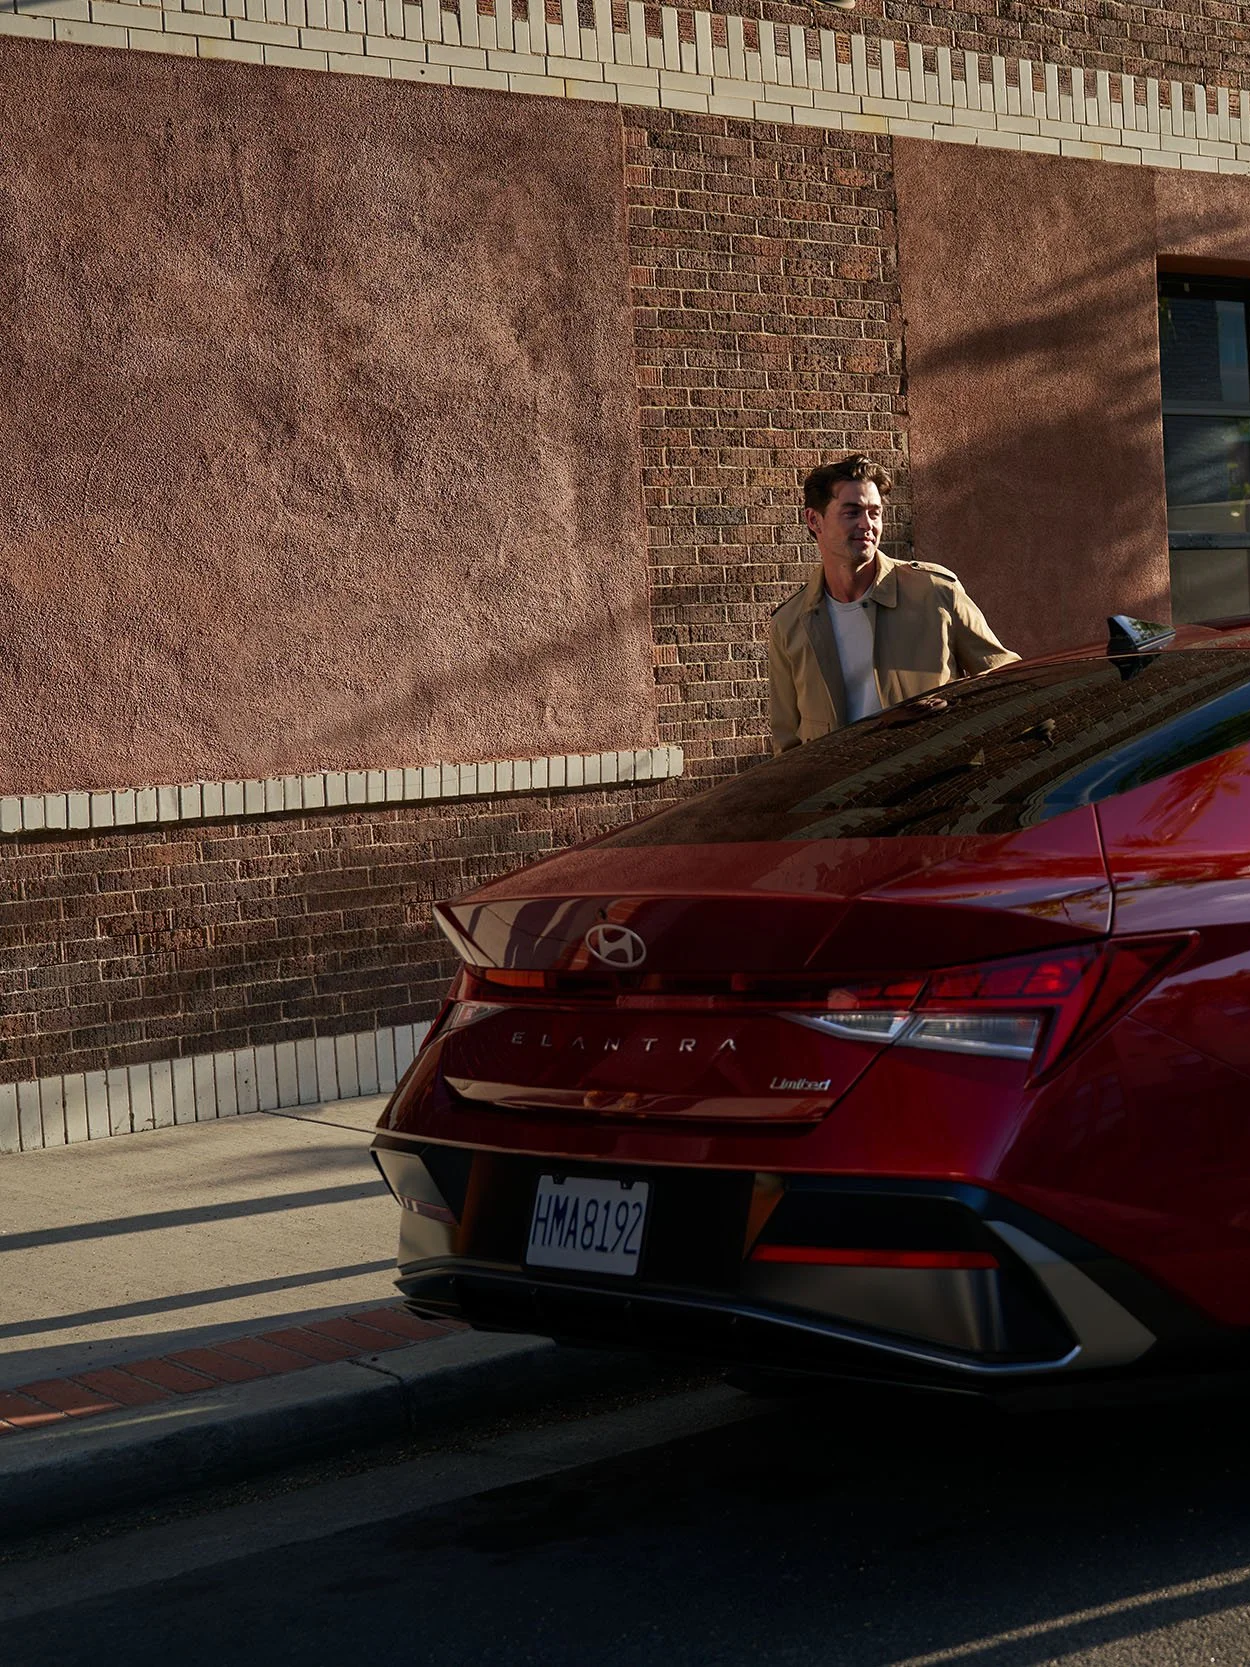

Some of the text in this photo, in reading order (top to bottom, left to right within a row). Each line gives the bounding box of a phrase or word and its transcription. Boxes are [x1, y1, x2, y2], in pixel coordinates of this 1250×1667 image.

[511, 1031, 737, 1052] ELANTRA
[769, 1076, 831, 1092] Limited
[531, 1193, 643, 1255] HMA8192
